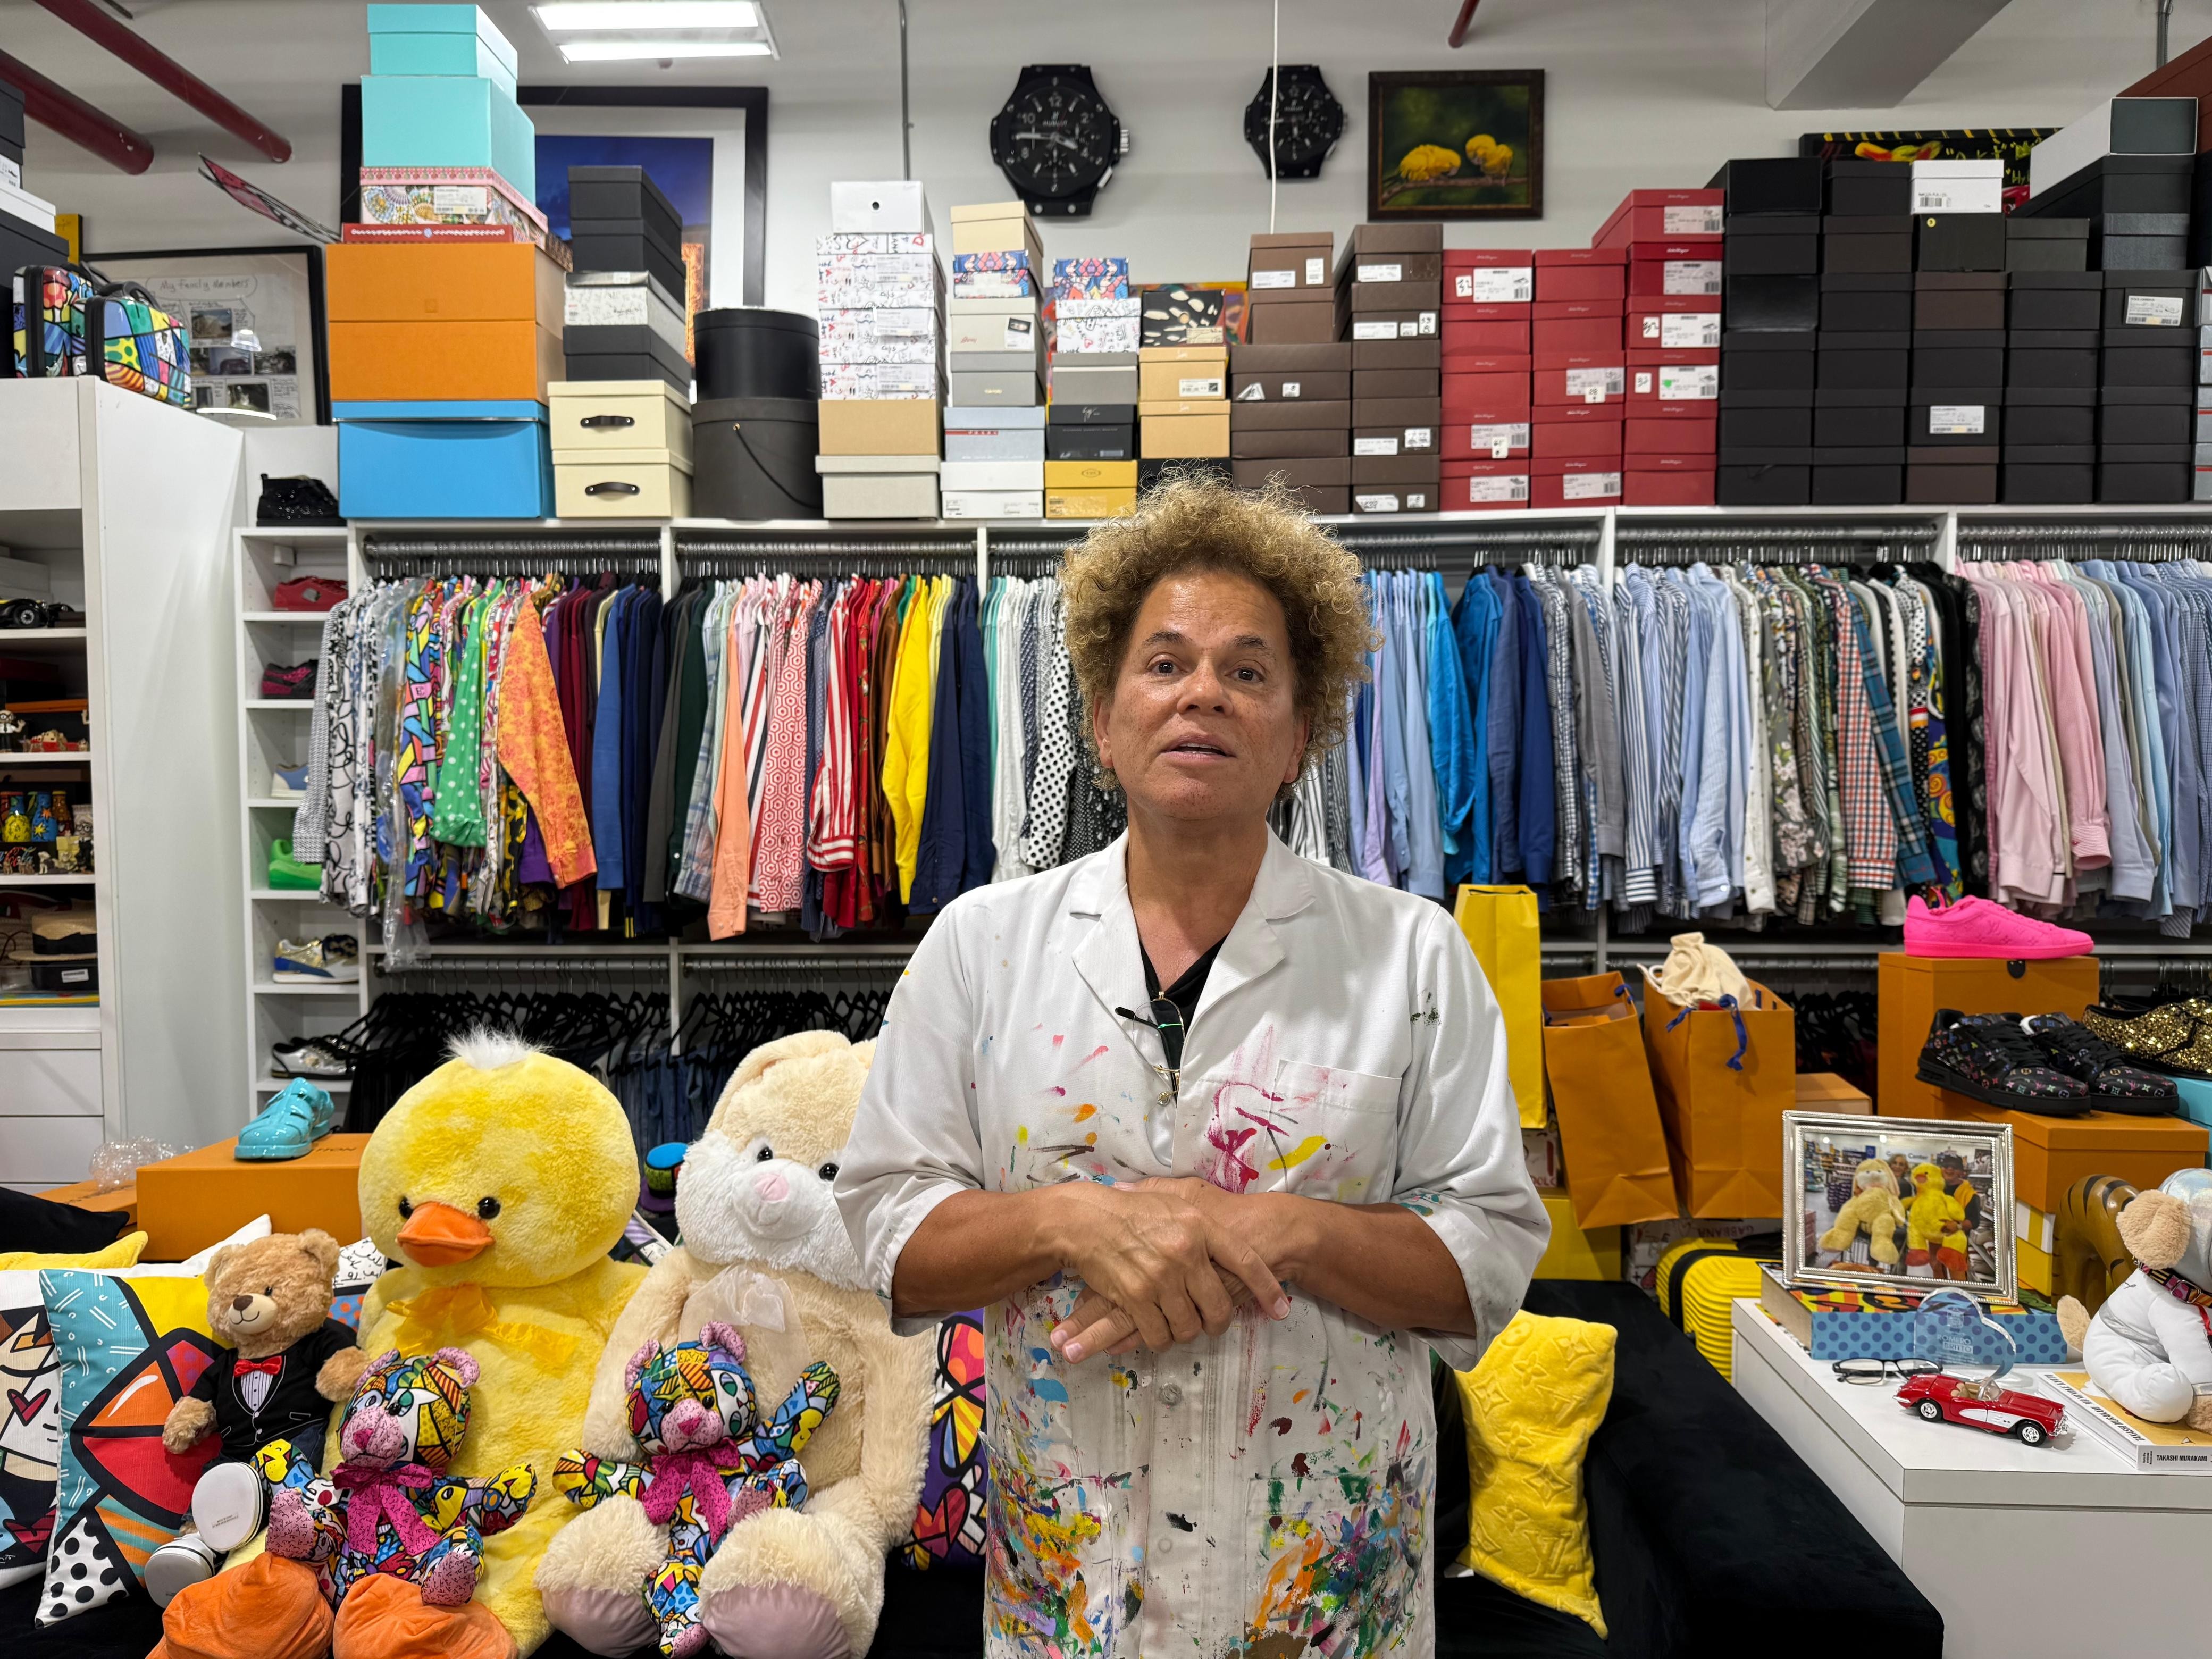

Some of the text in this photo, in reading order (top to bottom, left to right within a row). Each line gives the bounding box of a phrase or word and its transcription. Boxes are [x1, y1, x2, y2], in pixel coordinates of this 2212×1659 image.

[1021, 113, 1036, 124] 10
[161, 279, 250, 292] My Family Members
[1937, 1334, 1971, 1345] ROMERO
[1942, 1342, 1973, 1353] BRITTO
